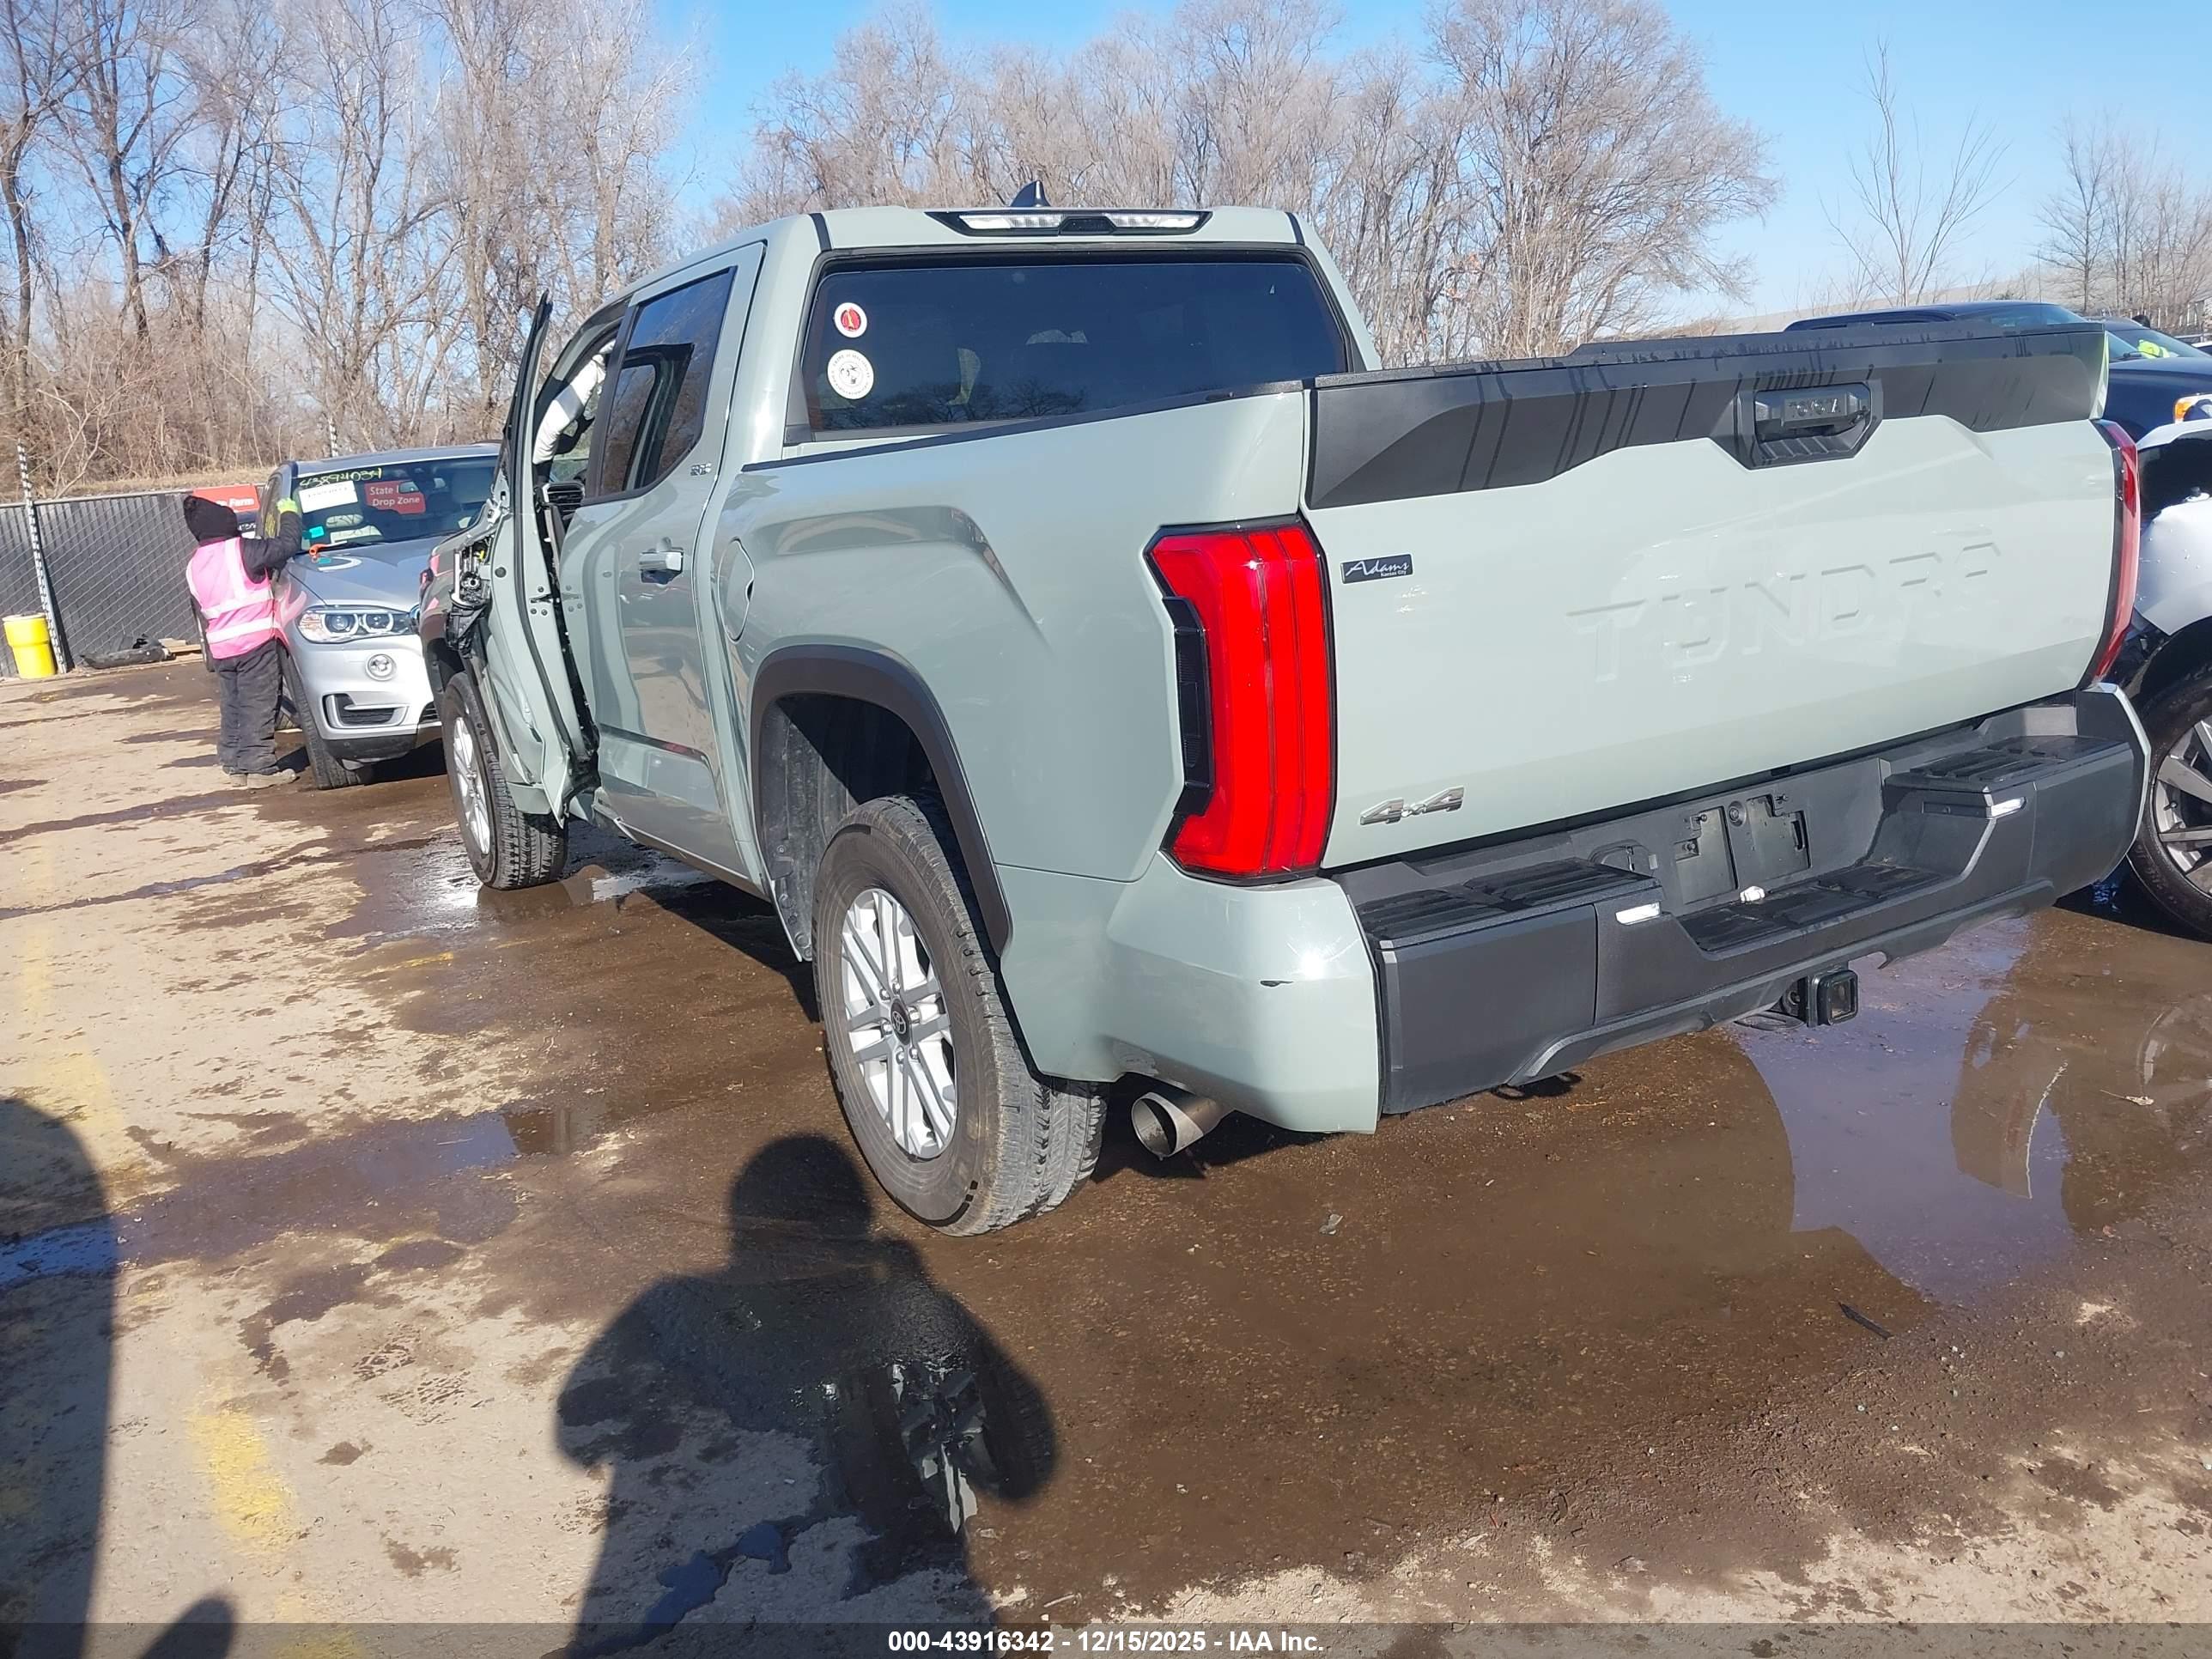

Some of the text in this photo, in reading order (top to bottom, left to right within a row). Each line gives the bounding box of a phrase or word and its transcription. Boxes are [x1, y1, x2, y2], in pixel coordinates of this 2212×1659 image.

[369, 486, 394, 495] State
[373, 496, 421, 507] Drop Zone
[1345, 560, 1409, 576] Adams
